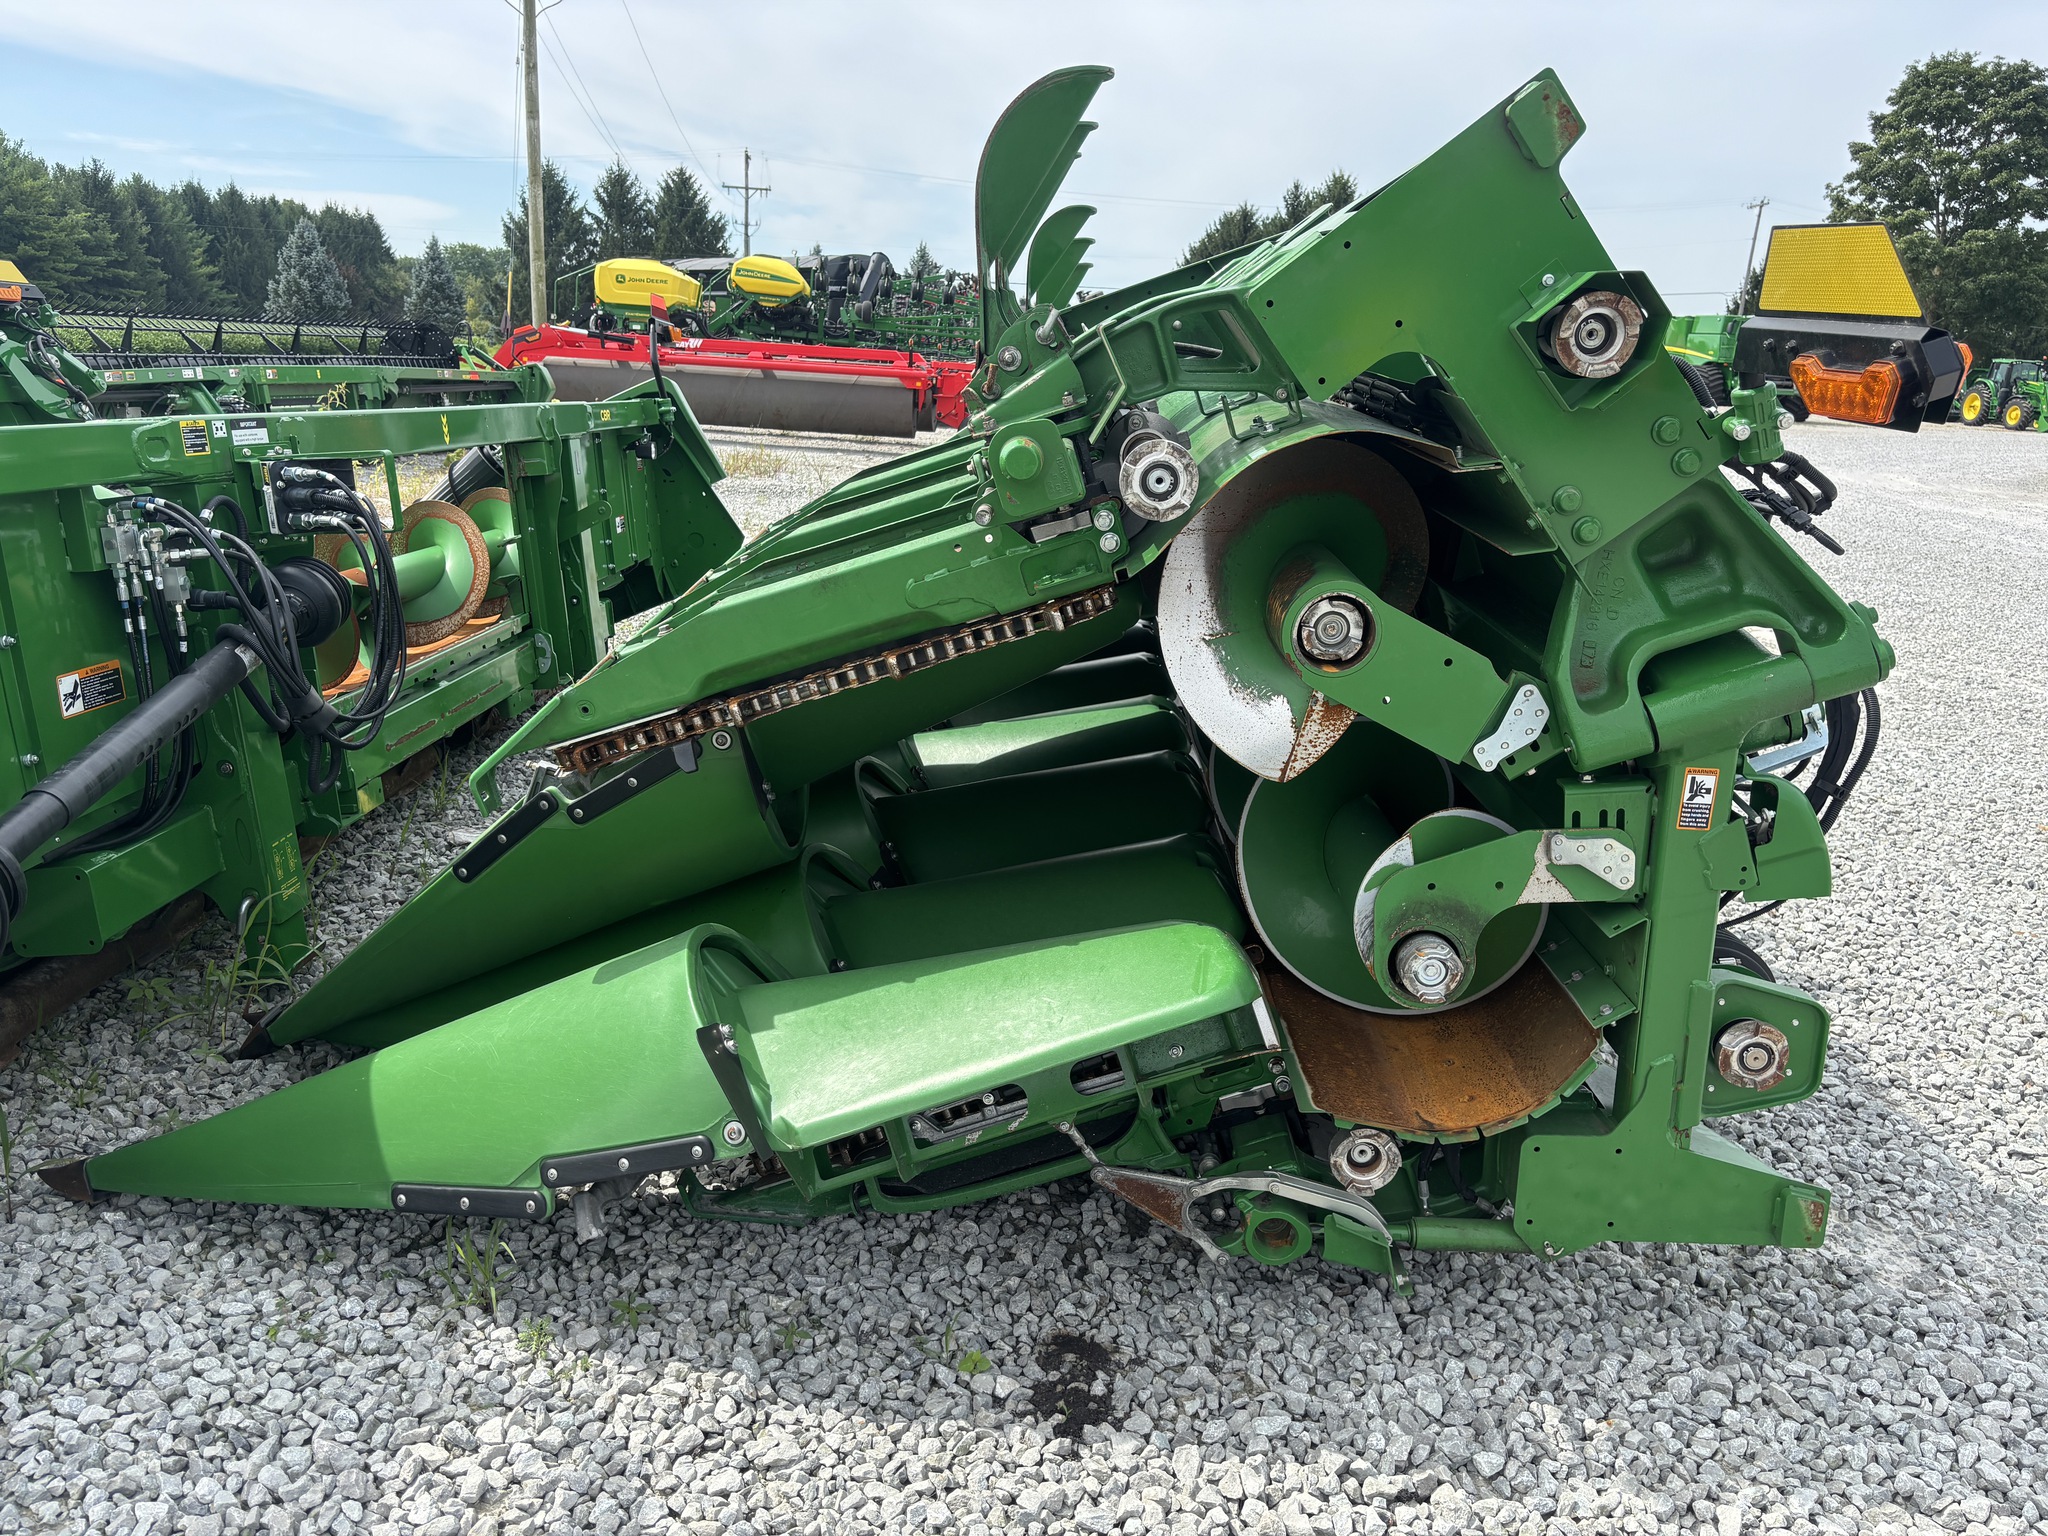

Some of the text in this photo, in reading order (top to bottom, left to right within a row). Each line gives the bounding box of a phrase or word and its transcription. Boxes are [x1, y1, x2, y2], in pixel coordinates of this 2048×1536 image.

[738, 269, 771, 279] JOHN DEERE
[646, 277, 669, 285] DEERE
[90, 664, 109, 673] WARNING
